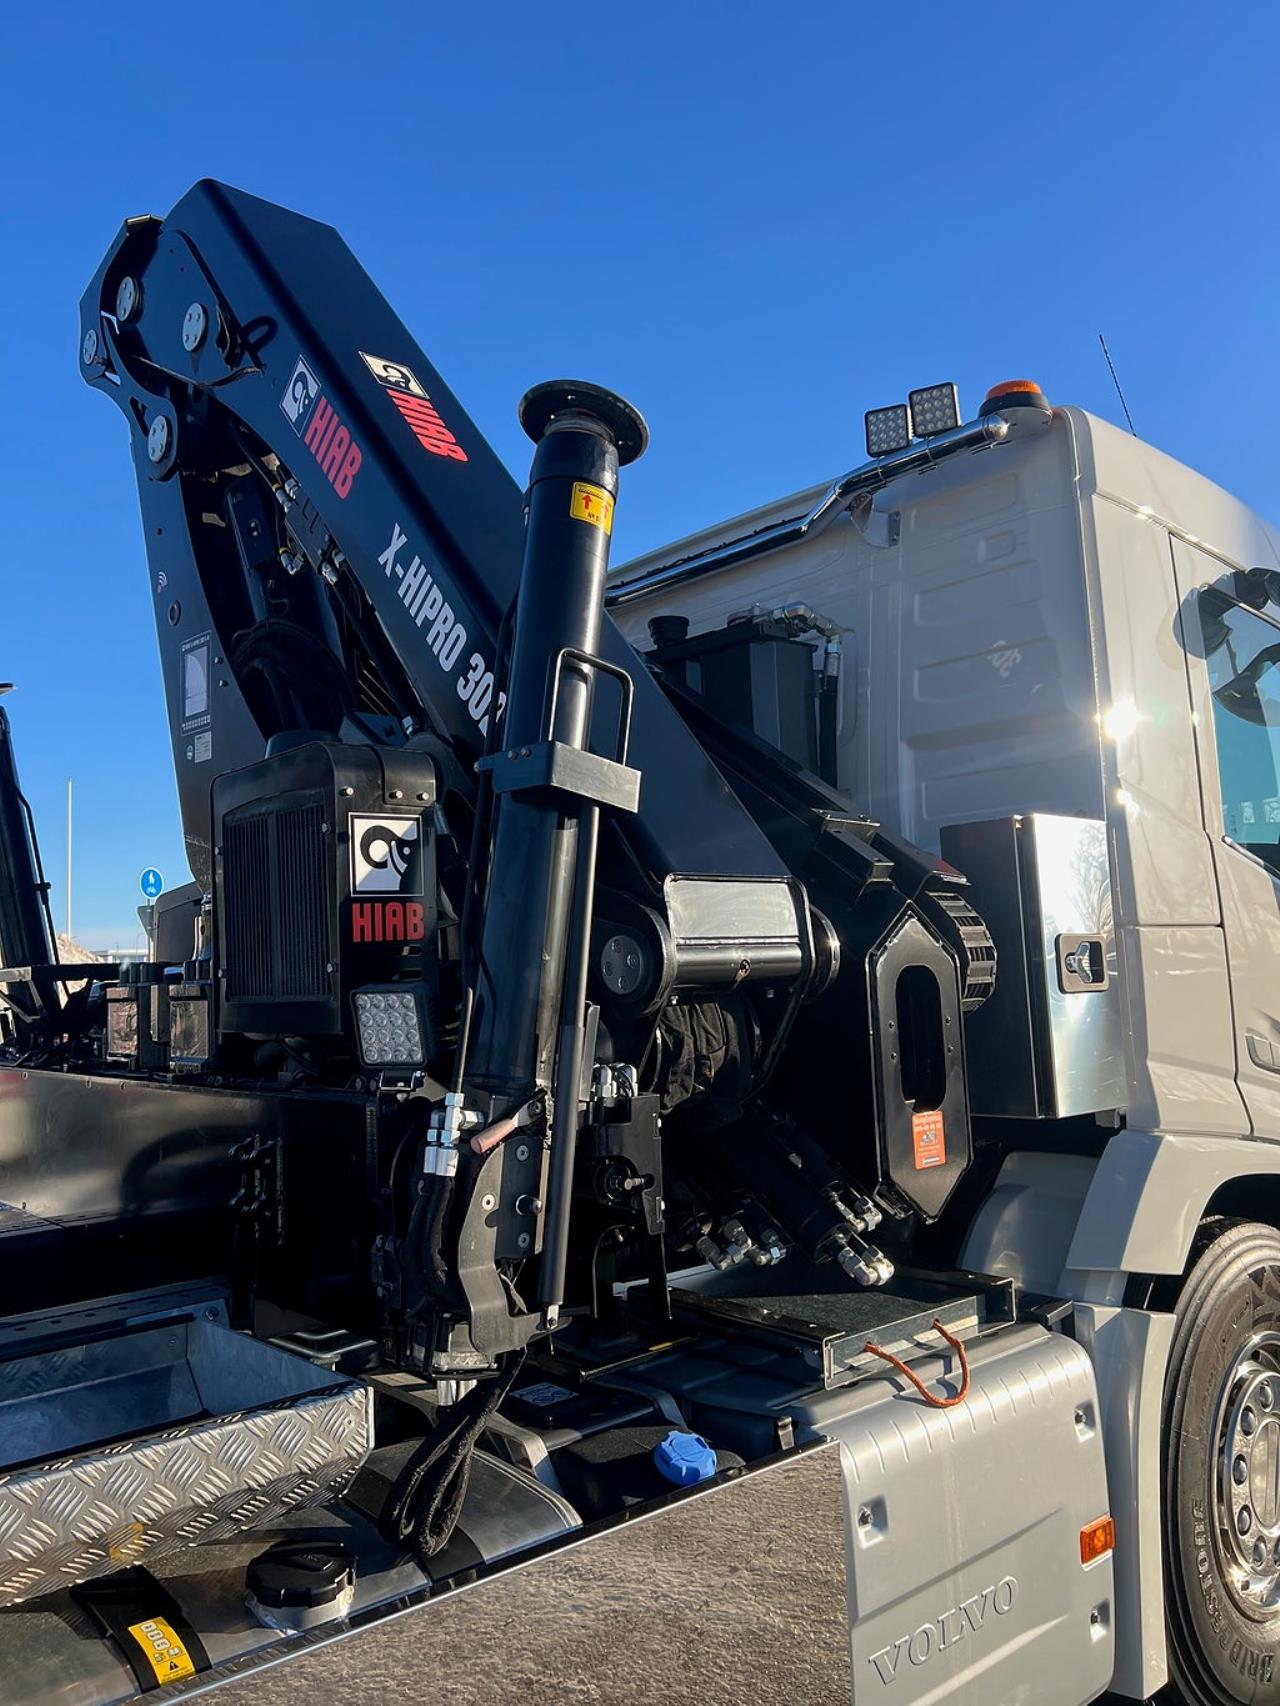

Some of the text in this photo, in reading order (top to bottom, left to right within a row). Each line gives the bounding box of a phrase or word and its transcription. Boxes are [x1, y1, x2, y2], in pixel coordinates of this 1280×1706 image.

[304, 394, 363, 500] HIAB
[386, 388, 469, 463] HIAB
[376, 522, 468, 673] X-HIPRO
[351, 901, 425, 943] HIAB
[868, 1575, 1019, 1686] VOLVO
